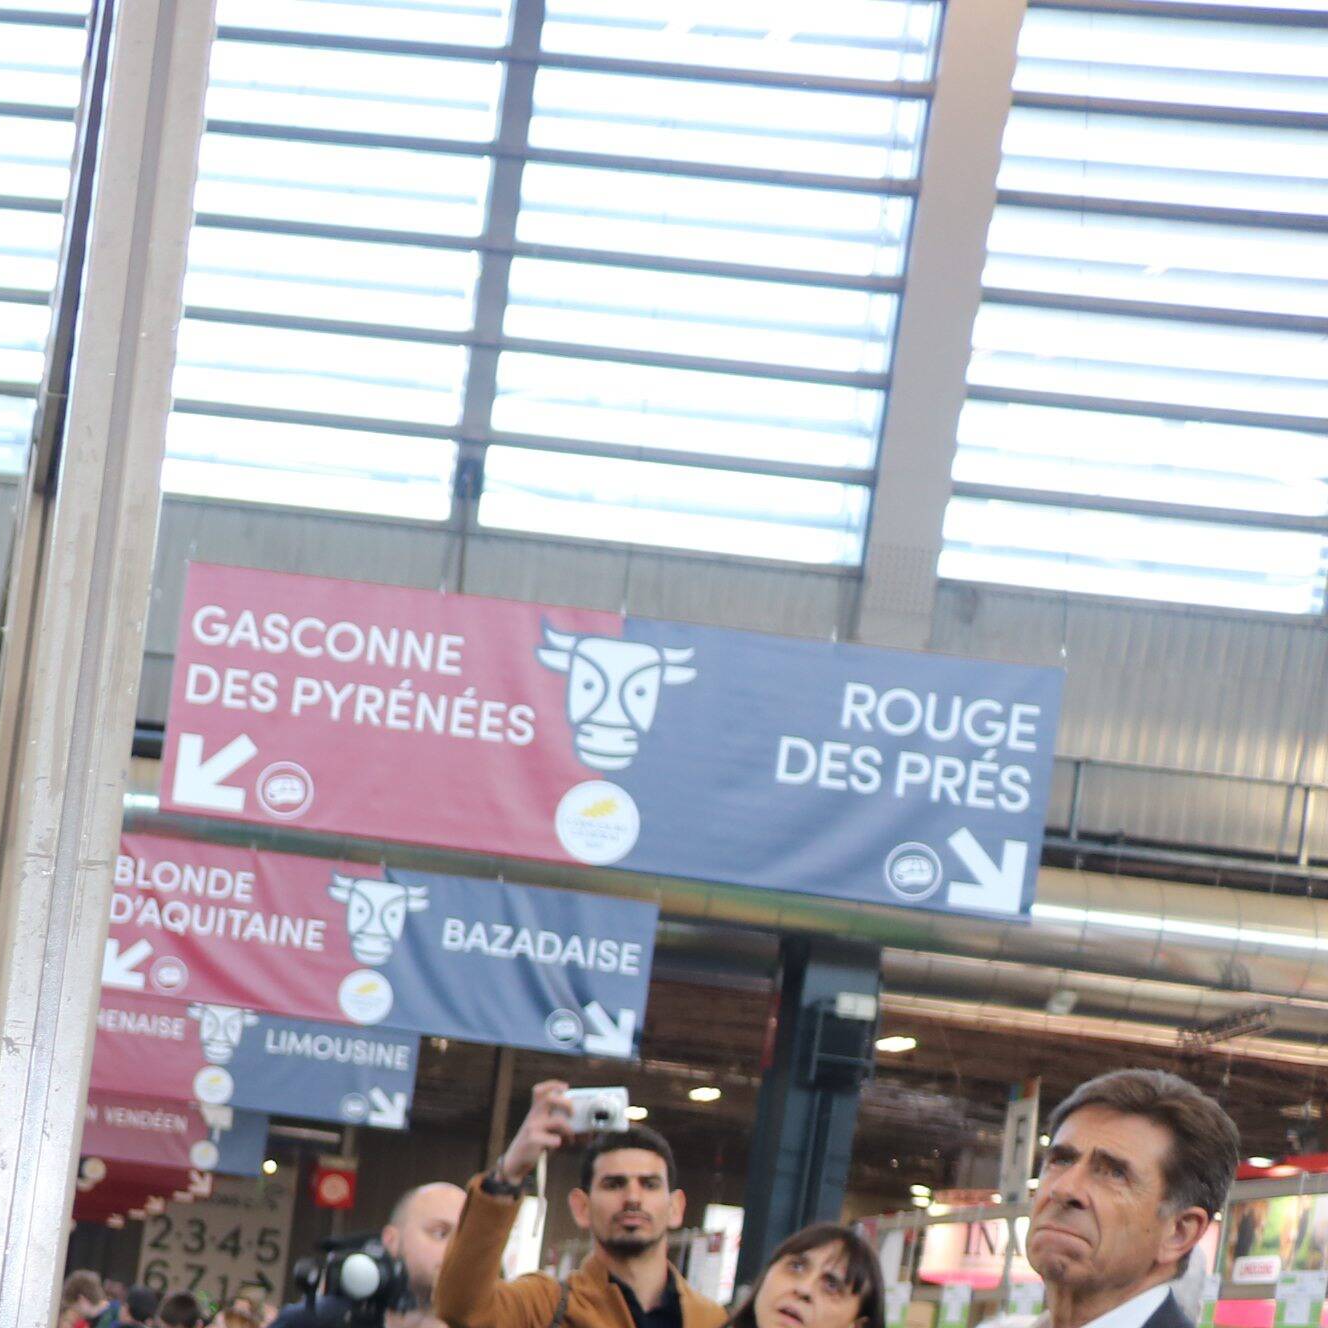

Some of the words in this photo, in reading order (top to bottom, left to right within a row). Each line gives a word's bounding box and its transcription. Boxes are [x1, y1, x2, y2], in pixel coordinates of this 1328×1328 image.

[191, 605, 465, 676] GASCONNE
[185, 663, 279, 713] DES
[290, 679, 536, 747] PYRÉNÉES
[841, 682, 1042, 753] ROUGE
[775, 736, 884, 795] DES
[894, 748, 1032, 814] PRÉS
[114, 854, 256, 904] BLONDE
[109, 892, 327, 951] D'AQUITAINE
[442, 917, 642, 976] BAZADAISE
[265, 1028, 412, 1072] LIMOUSINE
[104, 1104, 189, 1134] VENDÉEN
